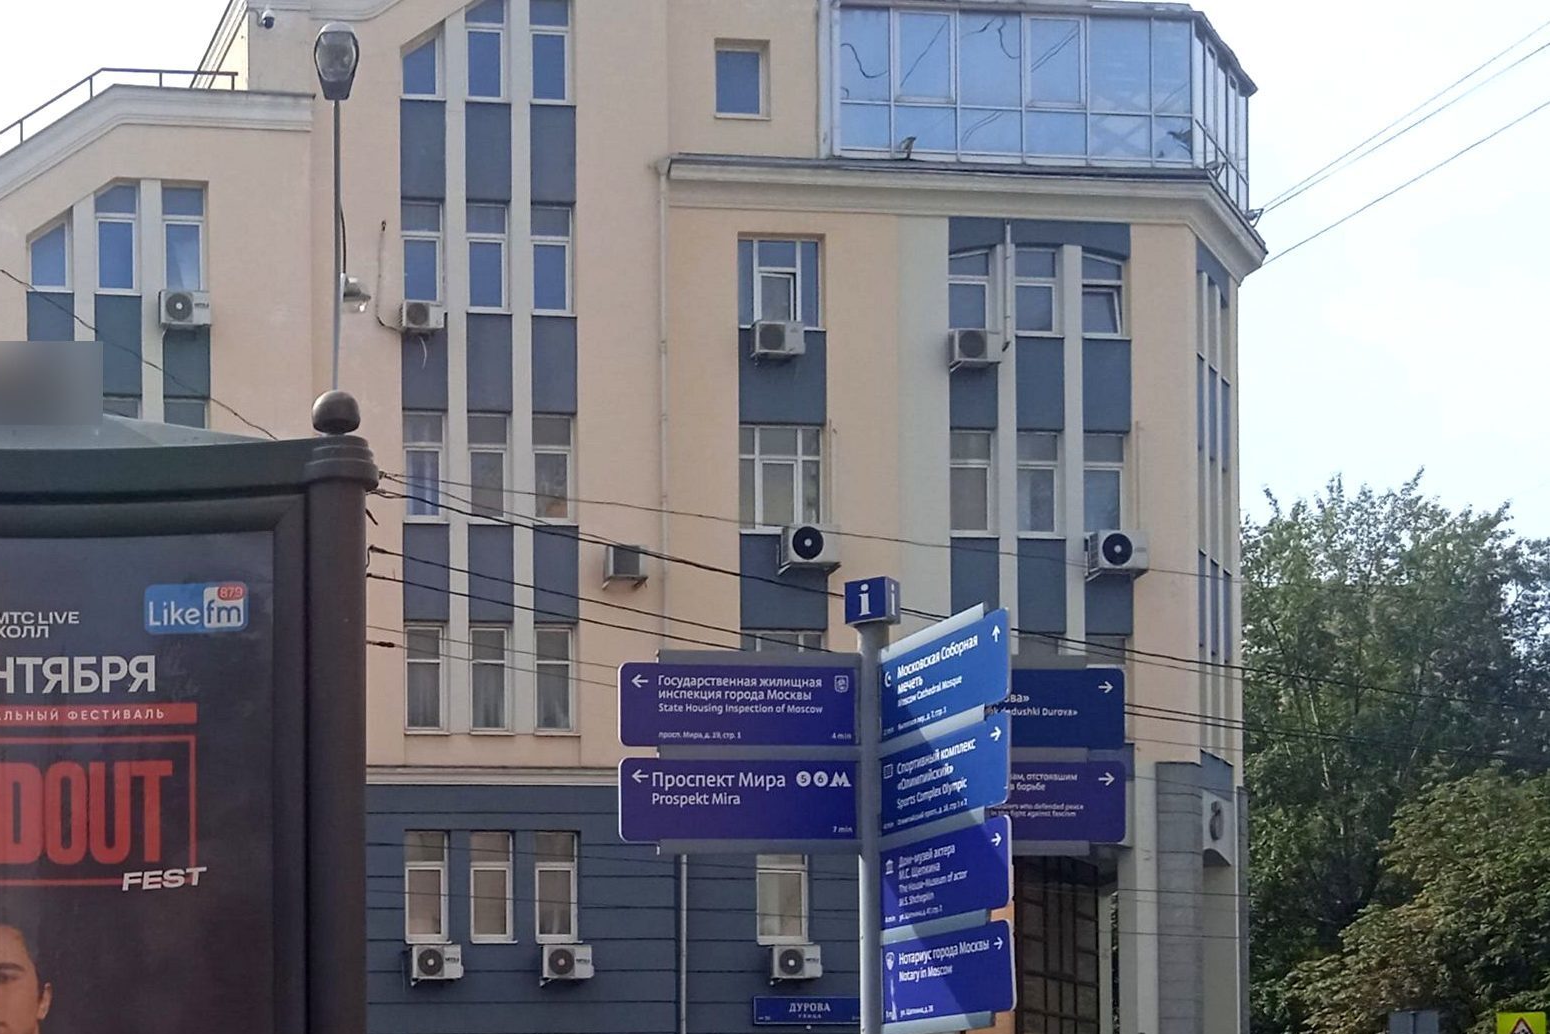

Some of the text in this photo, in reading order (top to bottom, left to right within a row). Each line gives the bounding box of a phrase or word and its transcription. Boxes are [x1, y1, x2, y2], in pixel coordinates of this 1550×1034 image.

[219, 586, 243, 599] 879
[38, 611, 80, 625] LIVE
[149, 600, 241, 626] Like fm
[941, 635, 978, 660] Соборная
[658, 674, 822, 689] Государственная жилищная
[658, 689, 811, 702] инспекция города Москвы
[67, 708, 165, 721] ФЕСТИВАЛЬ
[658, 703, 823, 715] State Housing Inspection of Moscow
[941, 739, 976, 759] комплекс
[652, 772, 735, 790] Проспект
[739, 772, 785, 790] Мира
[652, 793, 740, 808] Prospekt Mira
[122, 867, 207, 892] FEST
[899, 940, 990, 965] Нотариус города Москвы
[899, 970, 919, 982] Notary
[928, 965, 953, 978] Moscow
[789, 1002, 831, 1013] ДУРОВА
